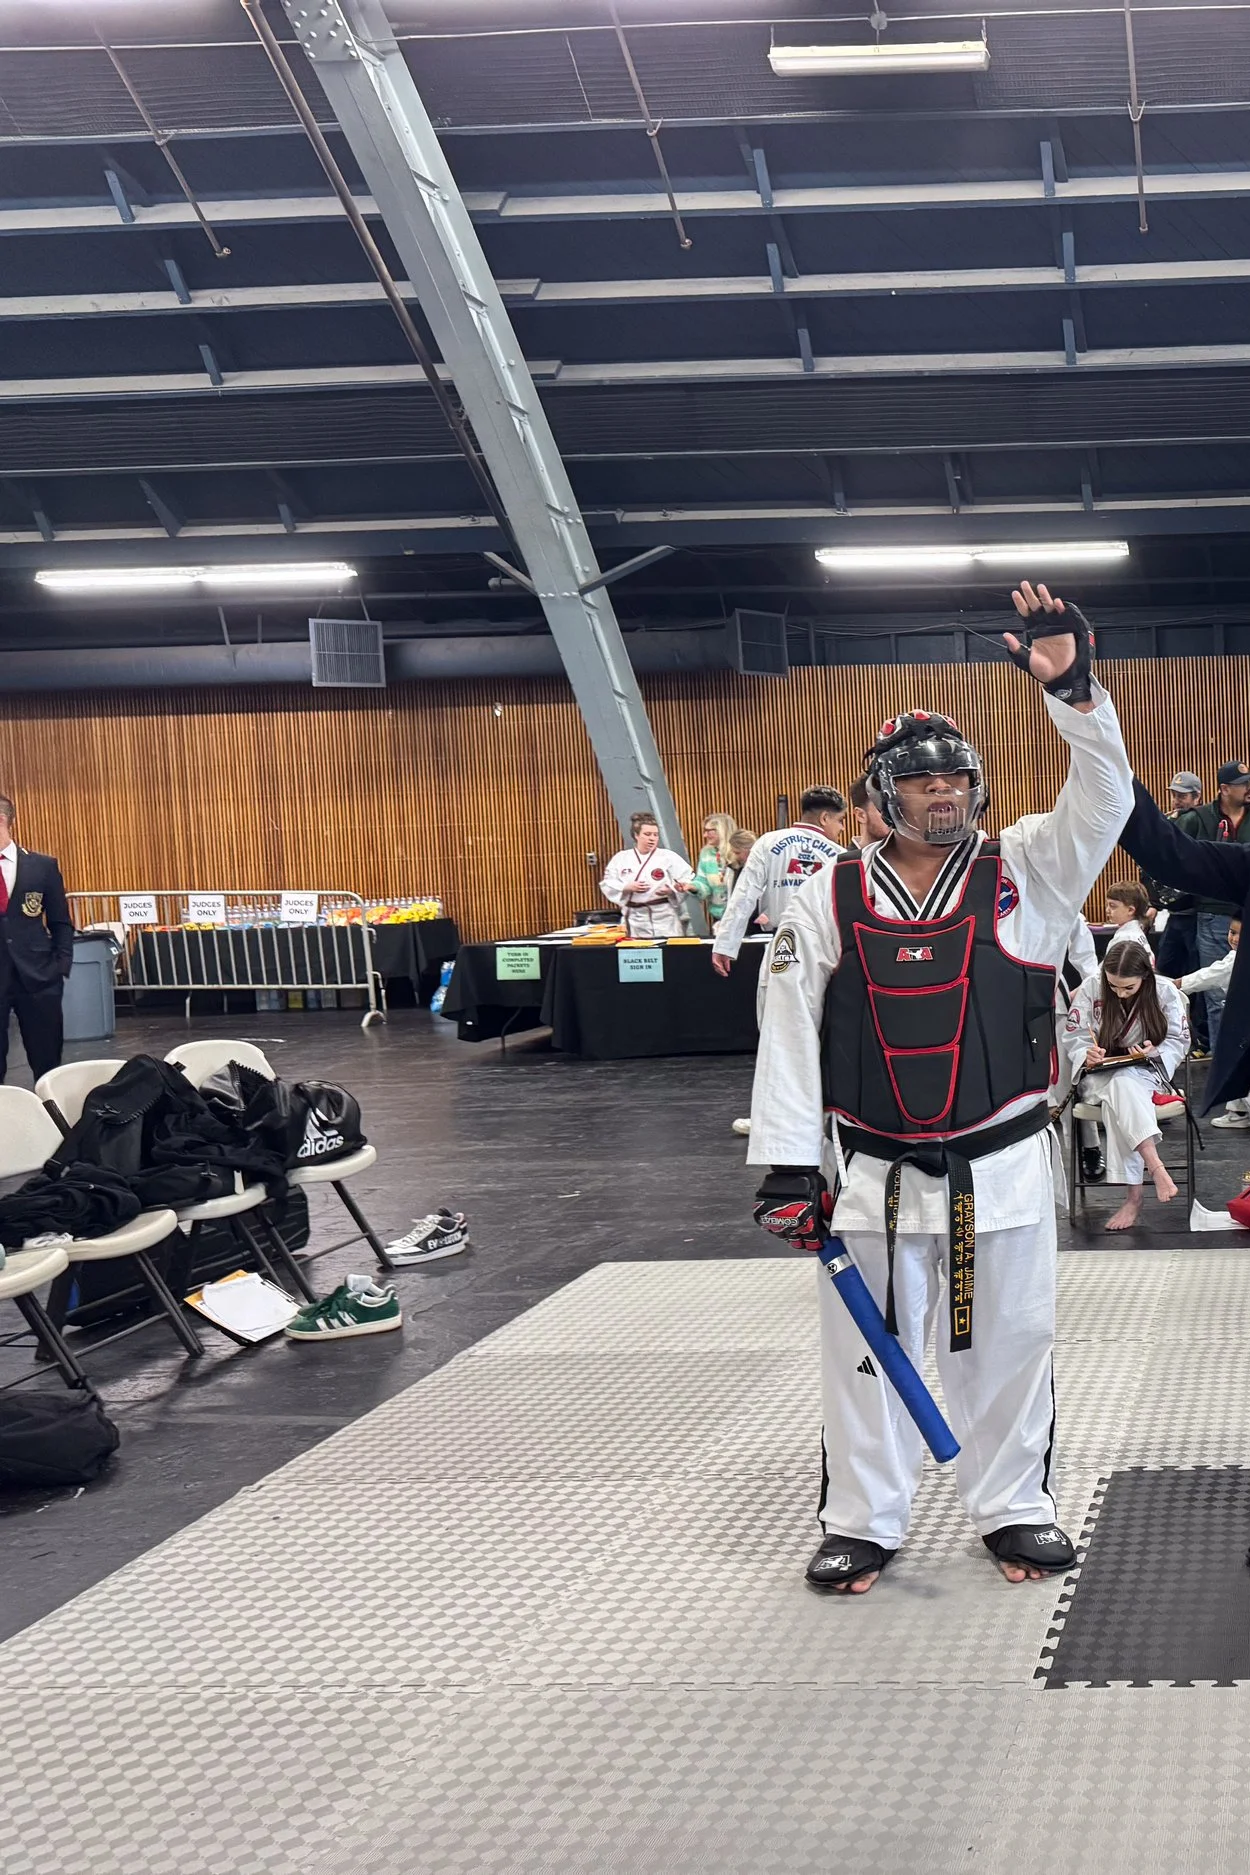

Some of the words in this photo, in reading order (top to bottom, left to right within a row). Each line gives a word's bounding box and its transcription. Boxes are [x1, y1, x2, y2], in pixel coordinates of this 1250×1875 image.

[771, 835, 812, 856] DISTRICT
[284, 899, 314, 907] JUDGES
[297, 1135, 344, 1158] adidas
[964, 1193, 975, 1248] GRAYSON
[964, 1252, 975, 1263] A.
[964, 1266, 974, 1300] JAIME
